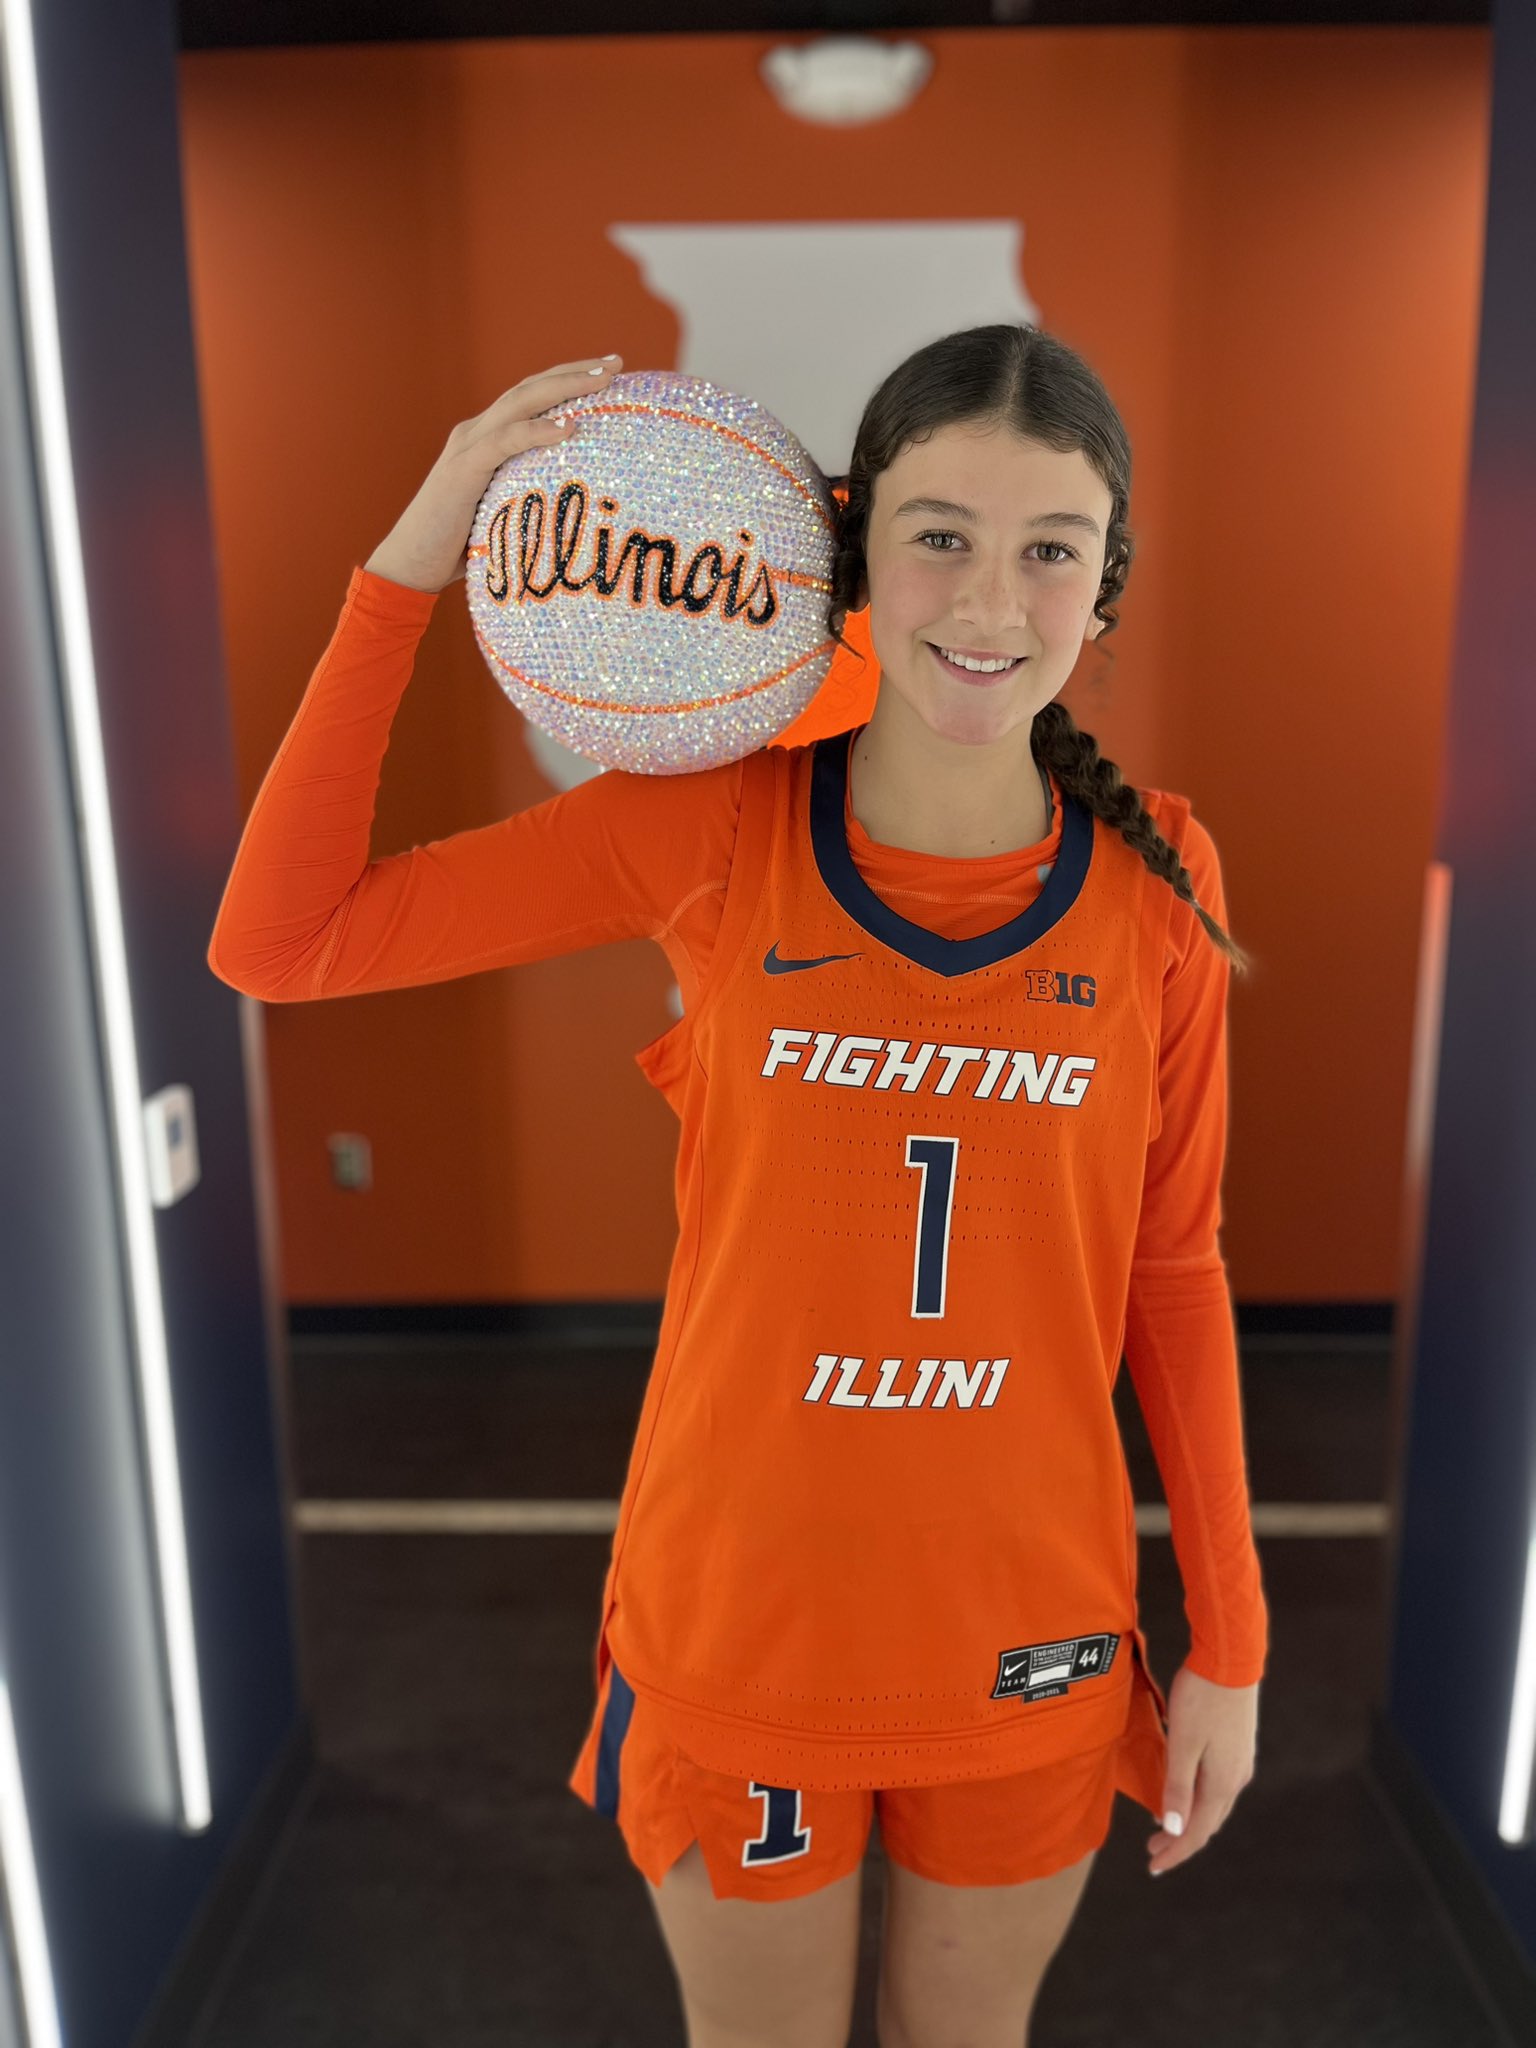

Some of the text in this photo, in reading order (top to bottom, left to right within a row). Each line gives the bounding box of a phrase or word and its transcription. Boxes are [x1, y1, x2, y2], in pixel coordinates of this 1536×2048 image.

[486, 479, 777, 629] Illinois
[760, 1027, 1097, 1107] FIGHTING
[905, 1135, 960, 1319] 1
[803, 1353, 1011, 1409] ILLINI
[1001, 1676, 1027, 1688] TEAM
[1033, 1644, 1075, 1658] ENGINEERED
[1078, 1647, 1099, 1667] 44
[741, 1781, 812, 1868] 1
